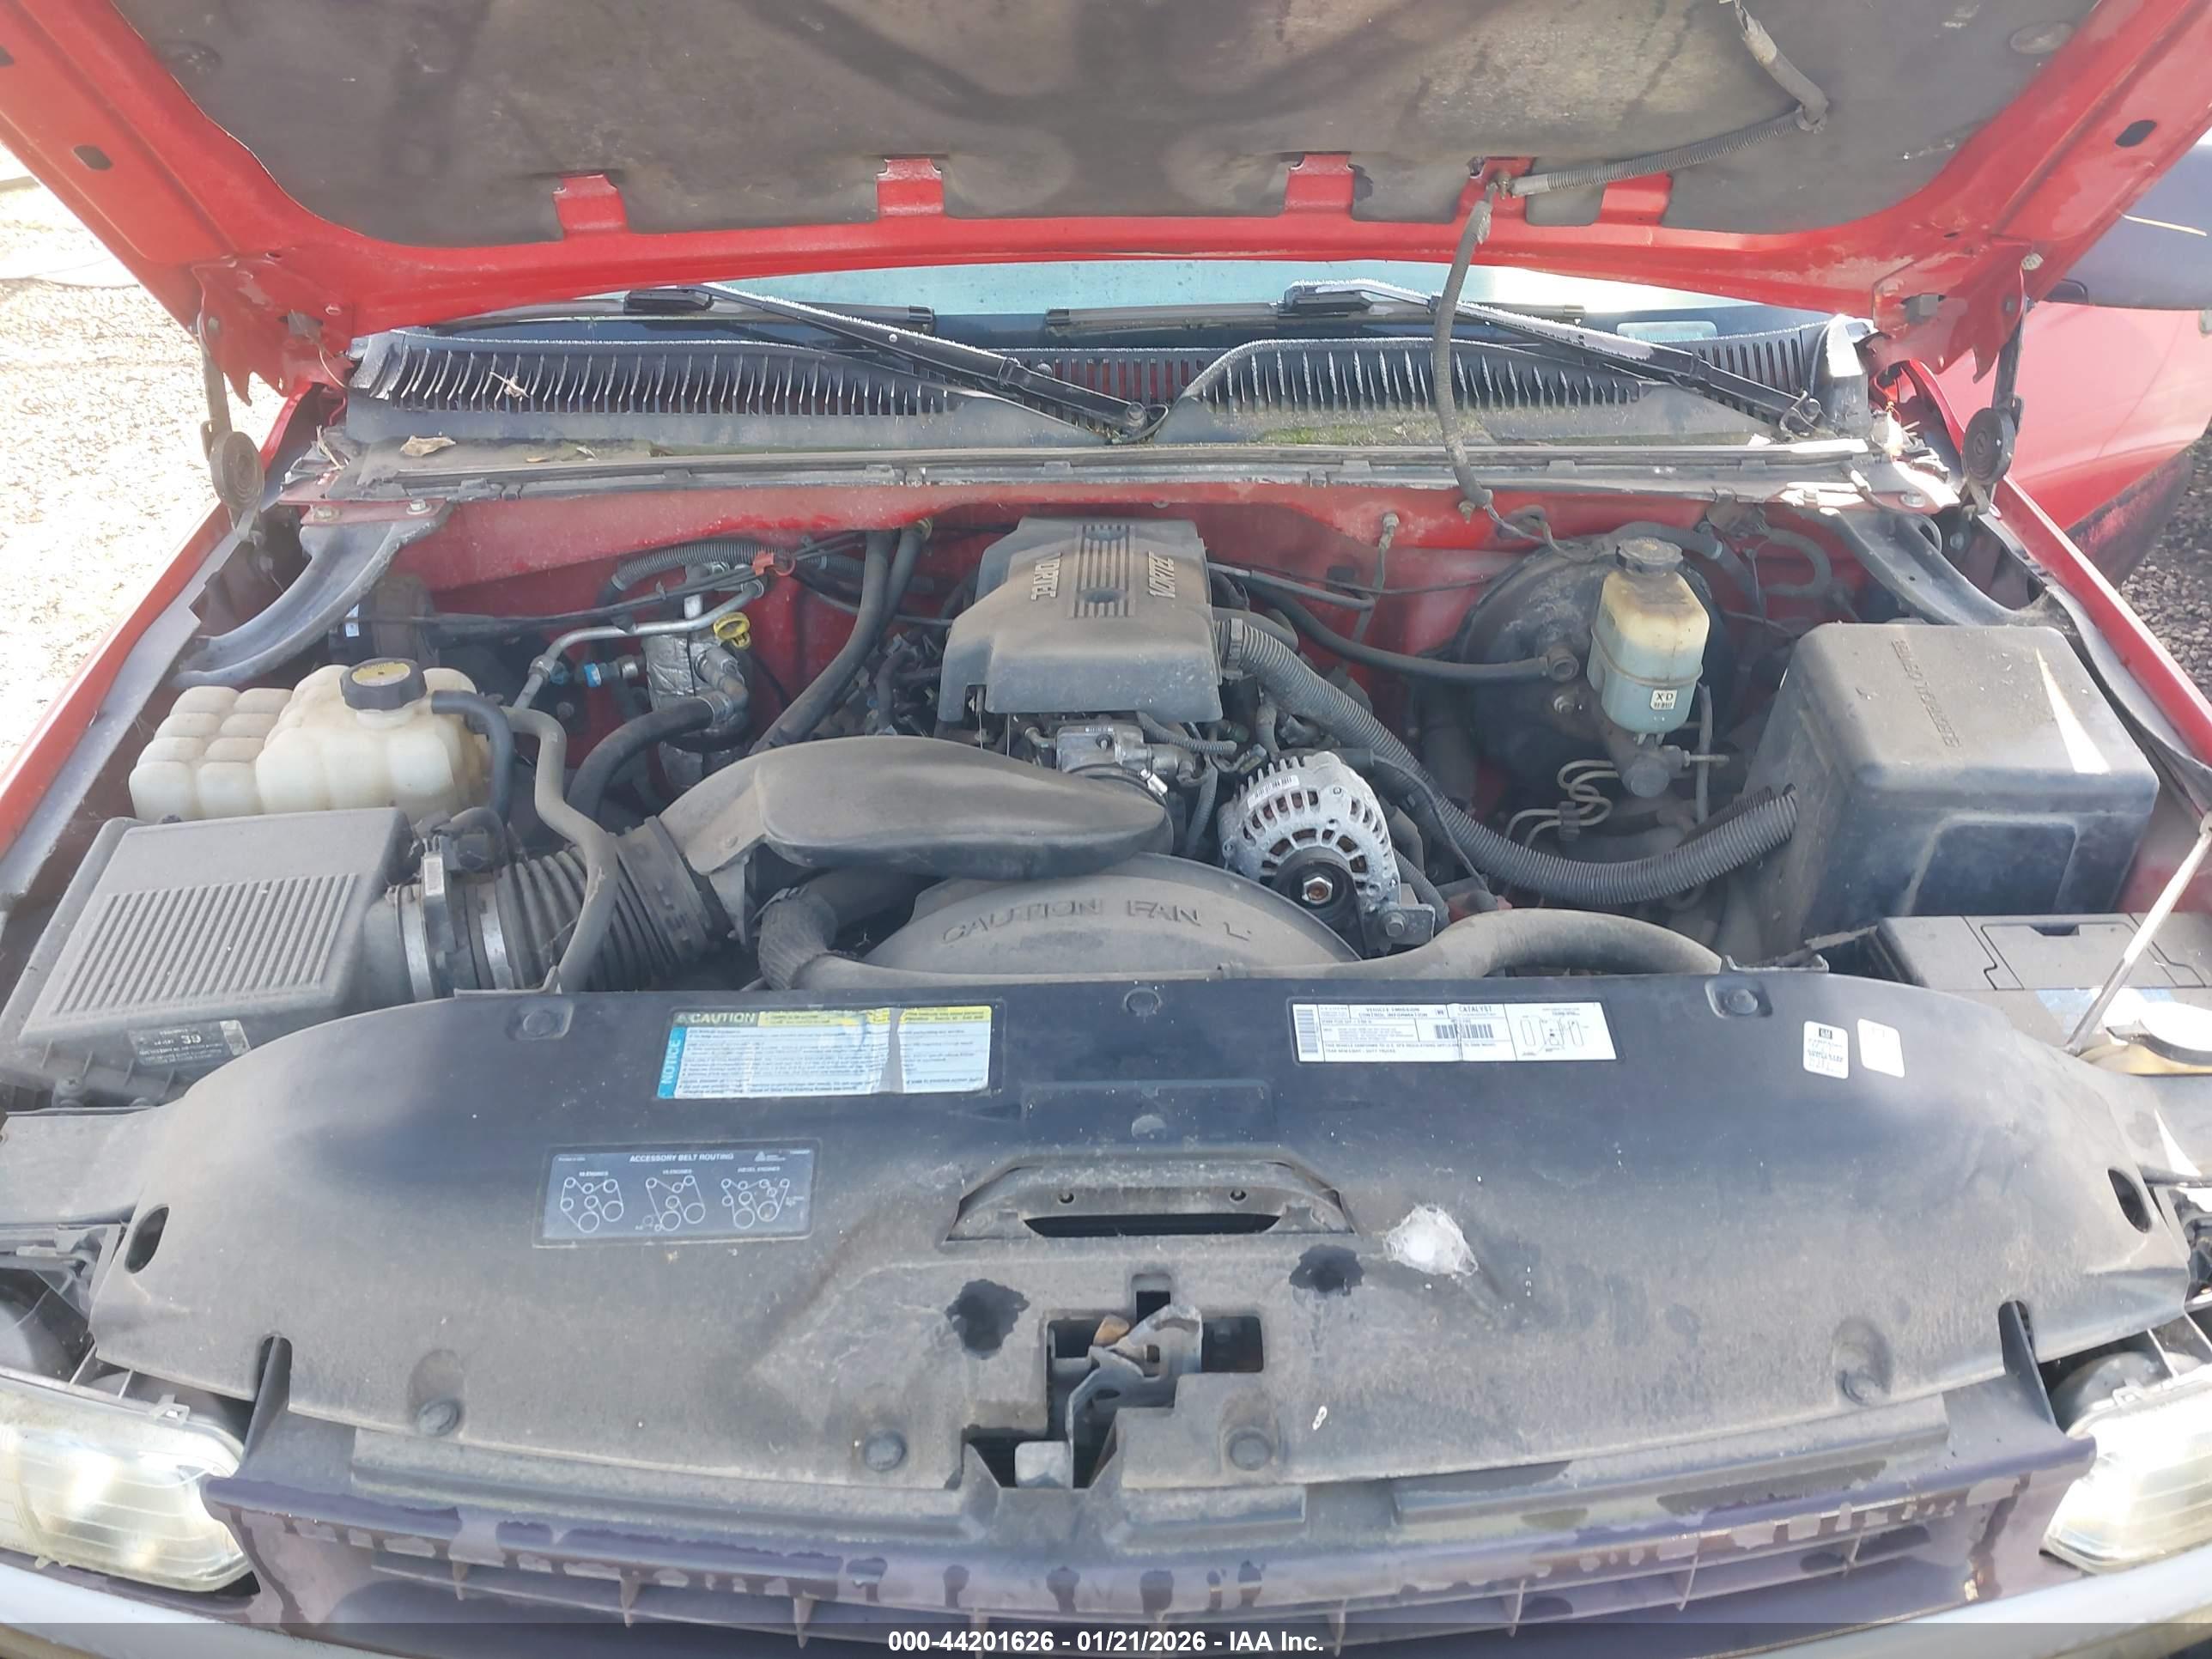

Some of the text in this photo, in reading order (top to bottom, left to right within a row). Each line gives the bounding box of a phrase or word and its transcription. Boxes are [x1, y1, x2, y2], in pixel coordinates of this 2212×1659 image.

[1148, 550, 1176, 599] VORTEC
[942, 898, 1103, 945] CAUTION
[1126, 899, 1201, 927] FAN
[690, 1012, 756, 1025] CAUTION
[660, 1038, 681, 1085] NOTICE
[629, 1152, 734, 1163] ACCESSORY BELT ROUTING
